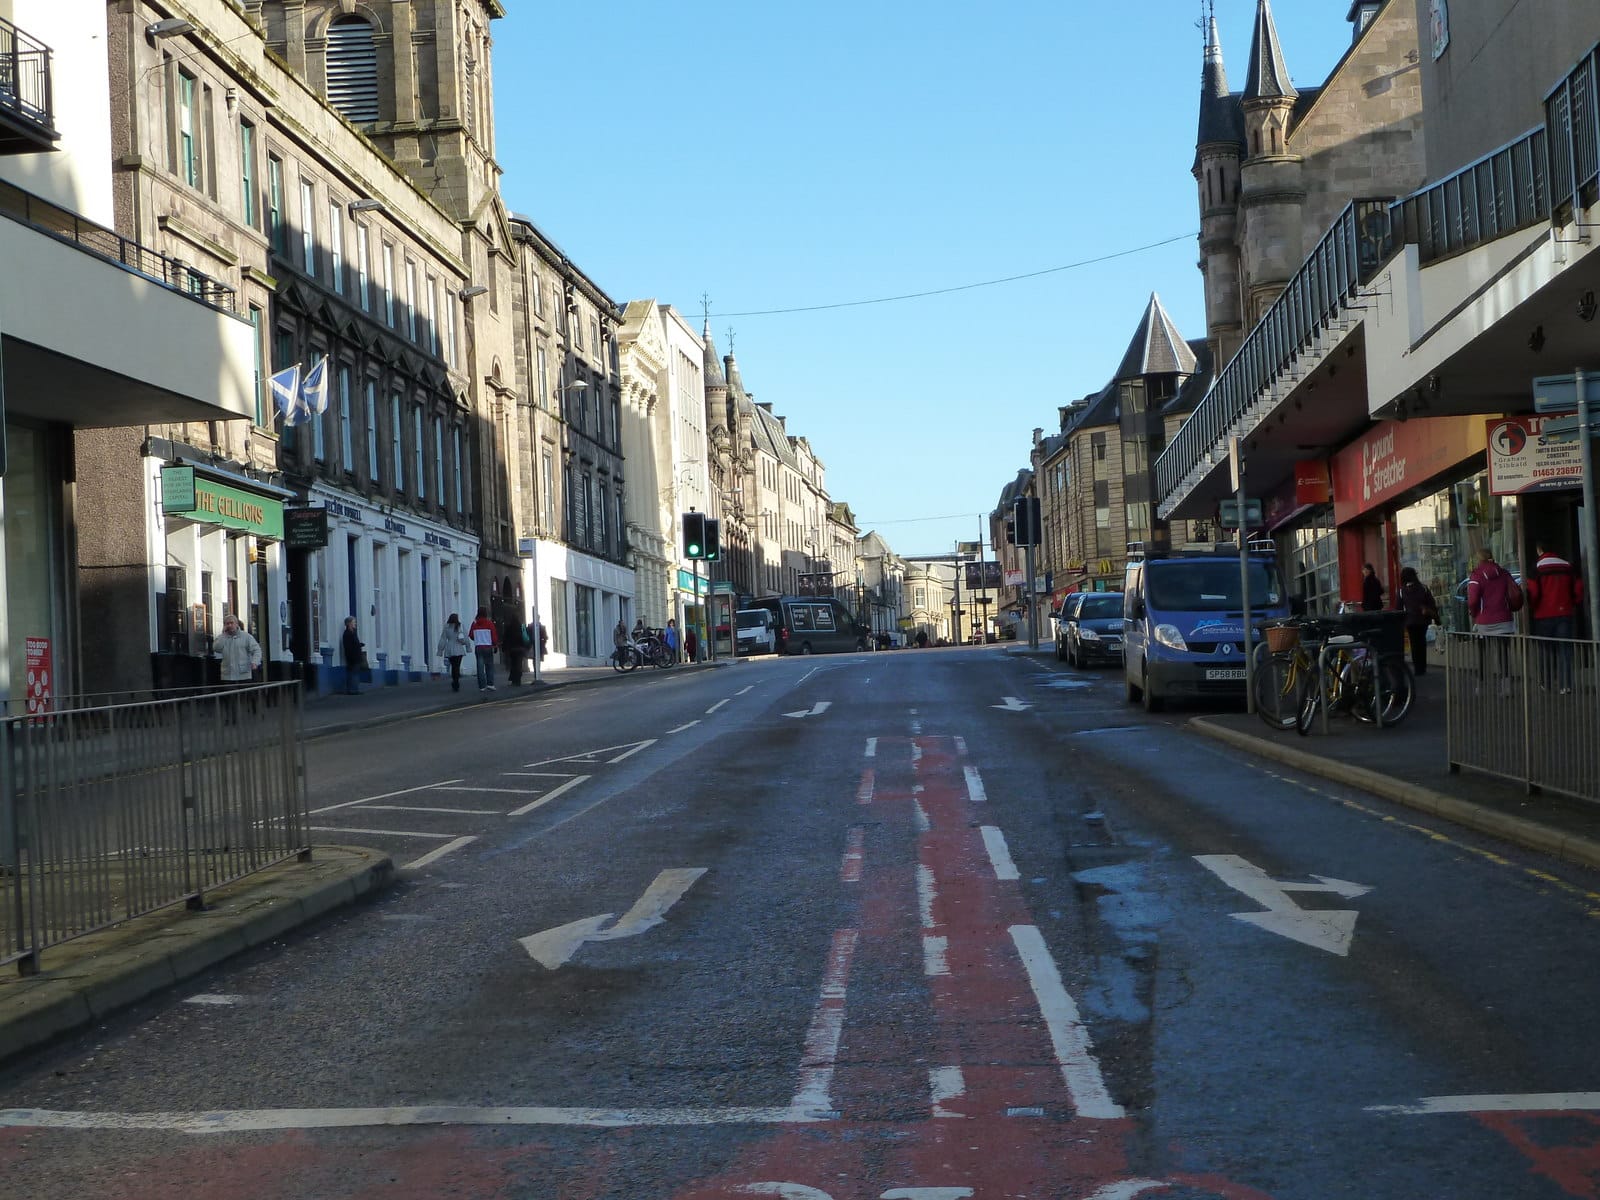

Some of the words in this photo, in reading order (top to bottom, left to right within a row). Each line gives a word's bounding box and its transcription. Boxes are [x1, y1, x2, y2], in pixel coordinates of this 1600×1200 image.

[1372, 425, 1394, 470] pound
[1373, 456, 1406, 493] stretcher
[1533, 468, 1554, 477] 01463
[1556, 466, 1582, 475] 236977
[196, 490, 215, 512] THE
[218, 496, 264, 525] GELLIONS
